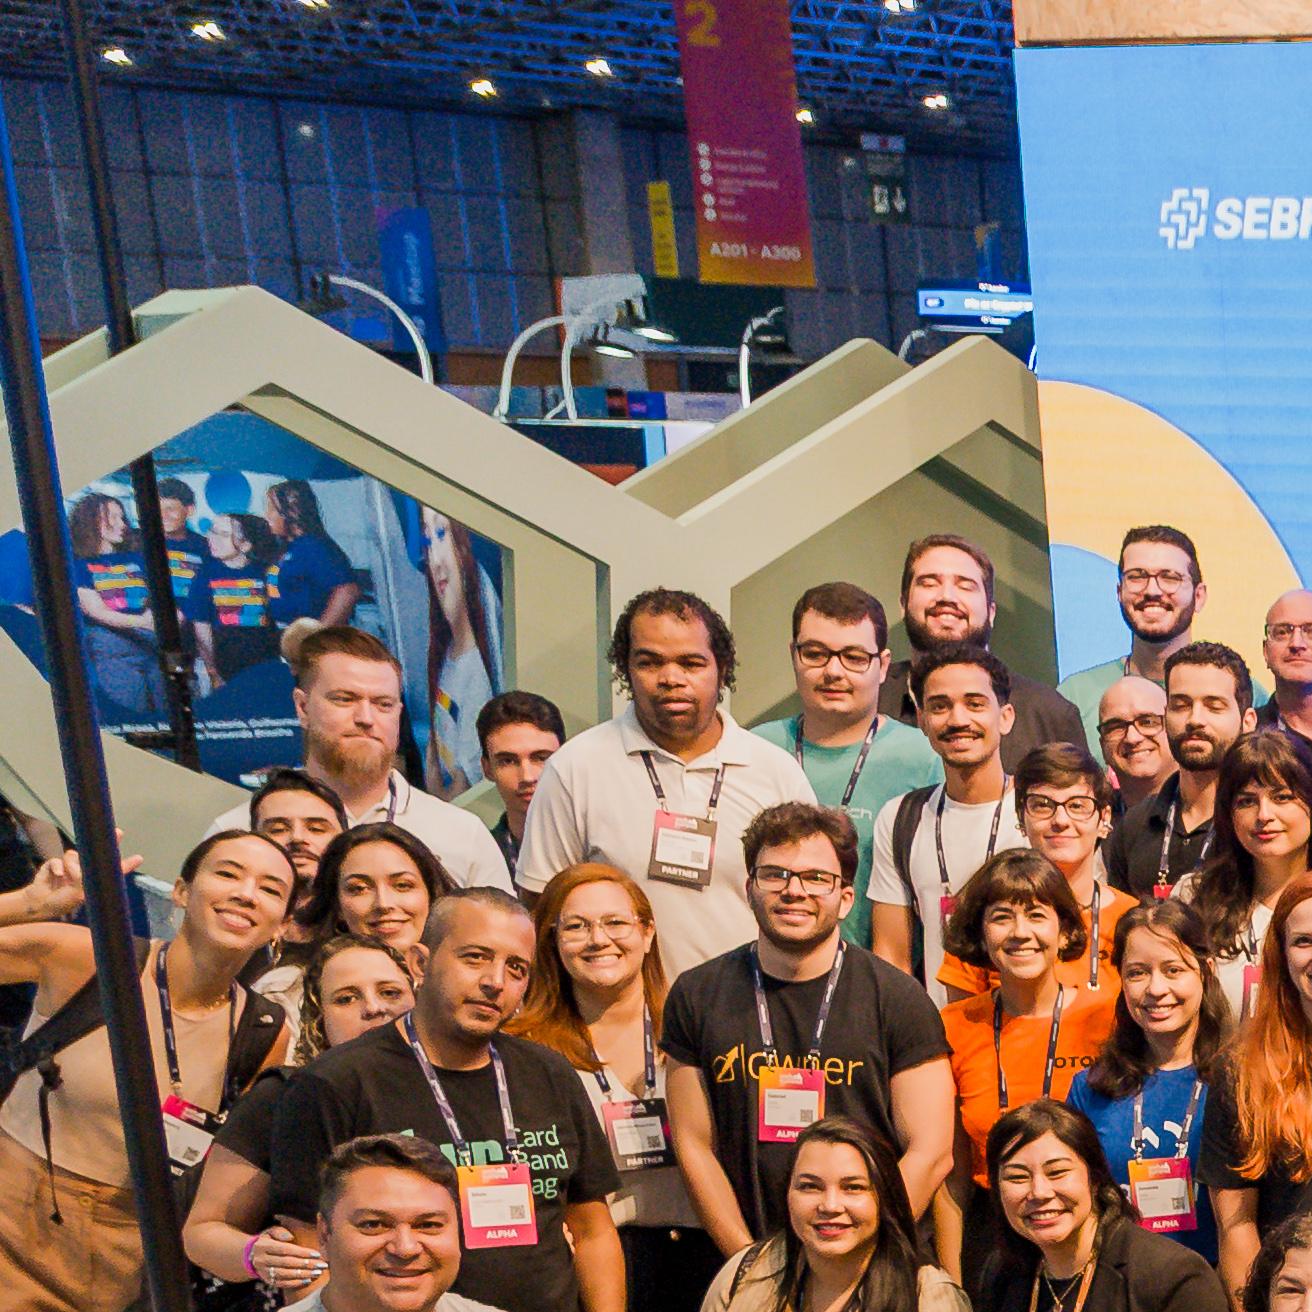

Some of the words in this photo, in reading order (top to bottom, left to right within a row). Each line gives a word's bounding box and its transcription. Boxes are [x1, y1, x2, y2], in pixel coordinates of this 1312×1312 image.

[684, 3, 721, 47] 2
[711, 241, 747, 257] A201
[776, 1130, 801, 1139] ALPH
[532, 1176, 558, 1199] ag
[1152, 1219, 1179, 1230] ALPHA
[486, 1229, 518, 1241] ALPHA
